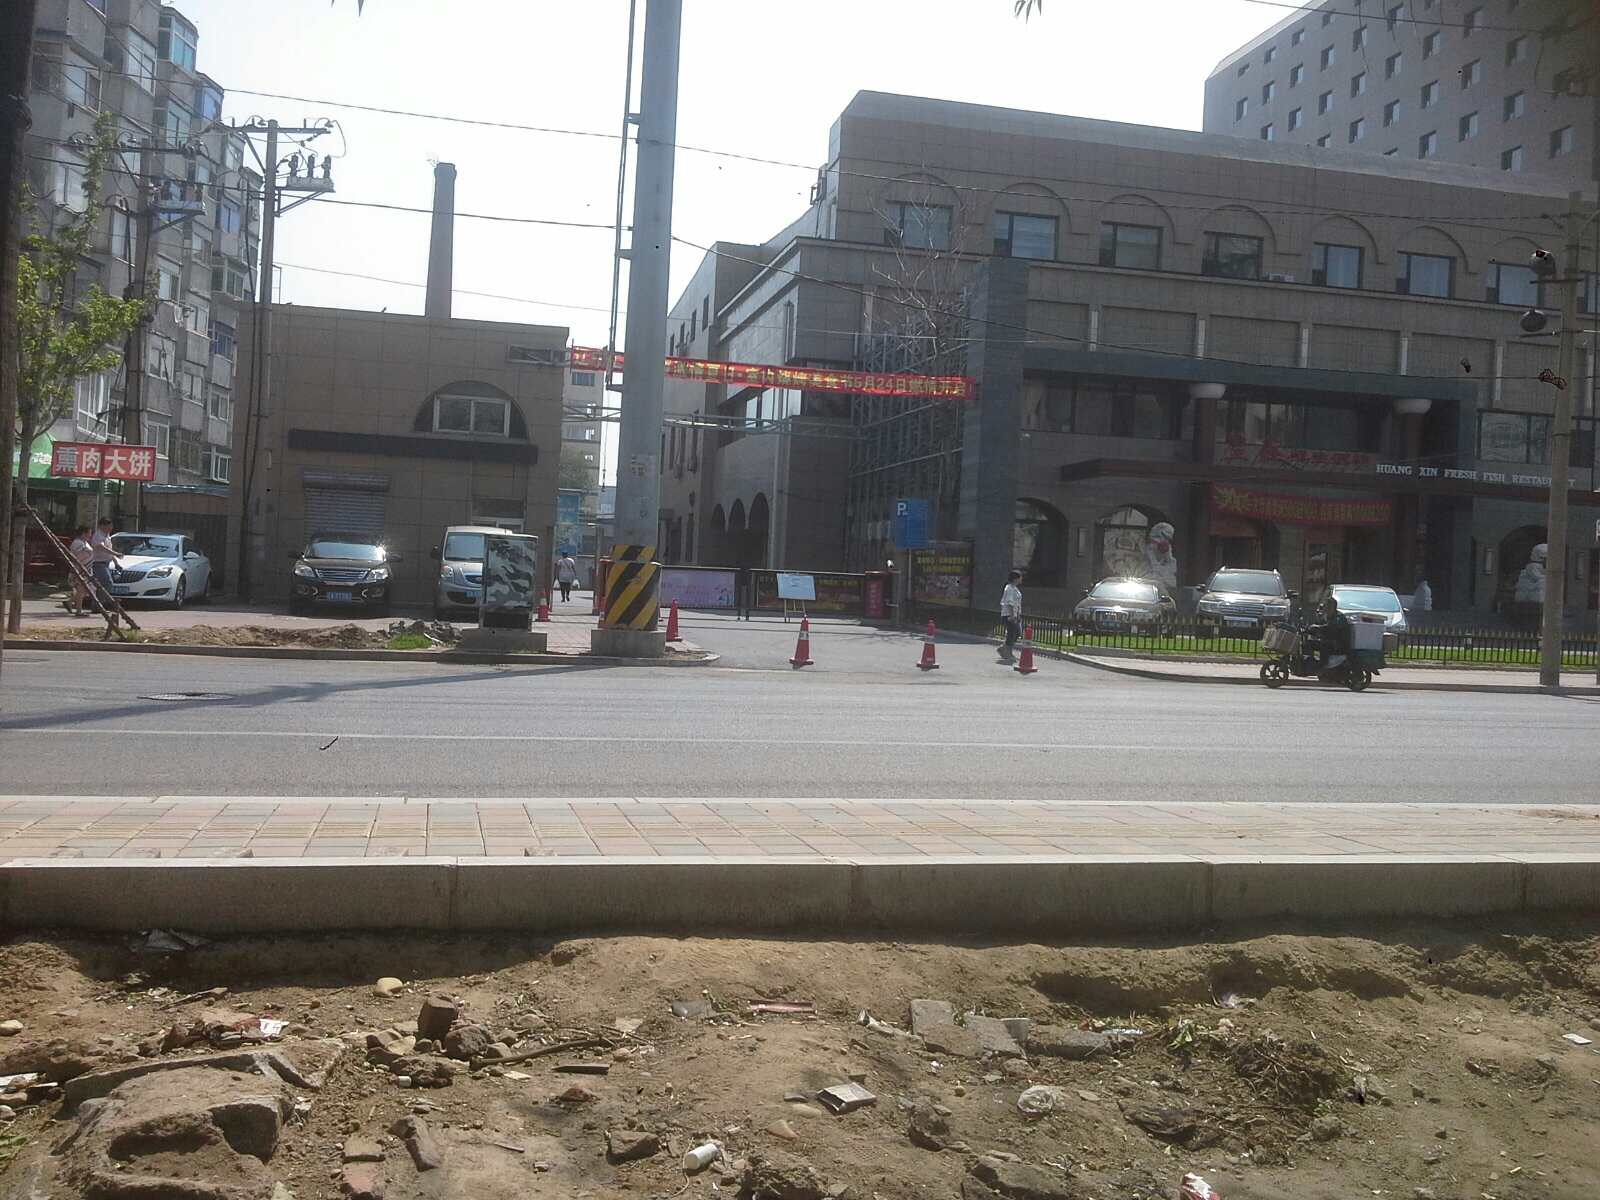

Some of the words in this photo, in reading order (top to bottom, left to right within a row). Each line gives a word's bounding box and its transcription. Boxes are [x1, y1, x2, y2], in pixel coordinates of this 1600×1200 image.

[56, 446, 152, 477] 熏肉大饼
[1376, 464, 1412, 475] HUANG
[1419, 467, 1438, 476] XIN
[1444, 469, 1477, 480] FRESH
[1483, 471, 1505, 483] FISH
[1512, 474, 1576, 488] RESTAUT
[897, 502, 907, 516] P
